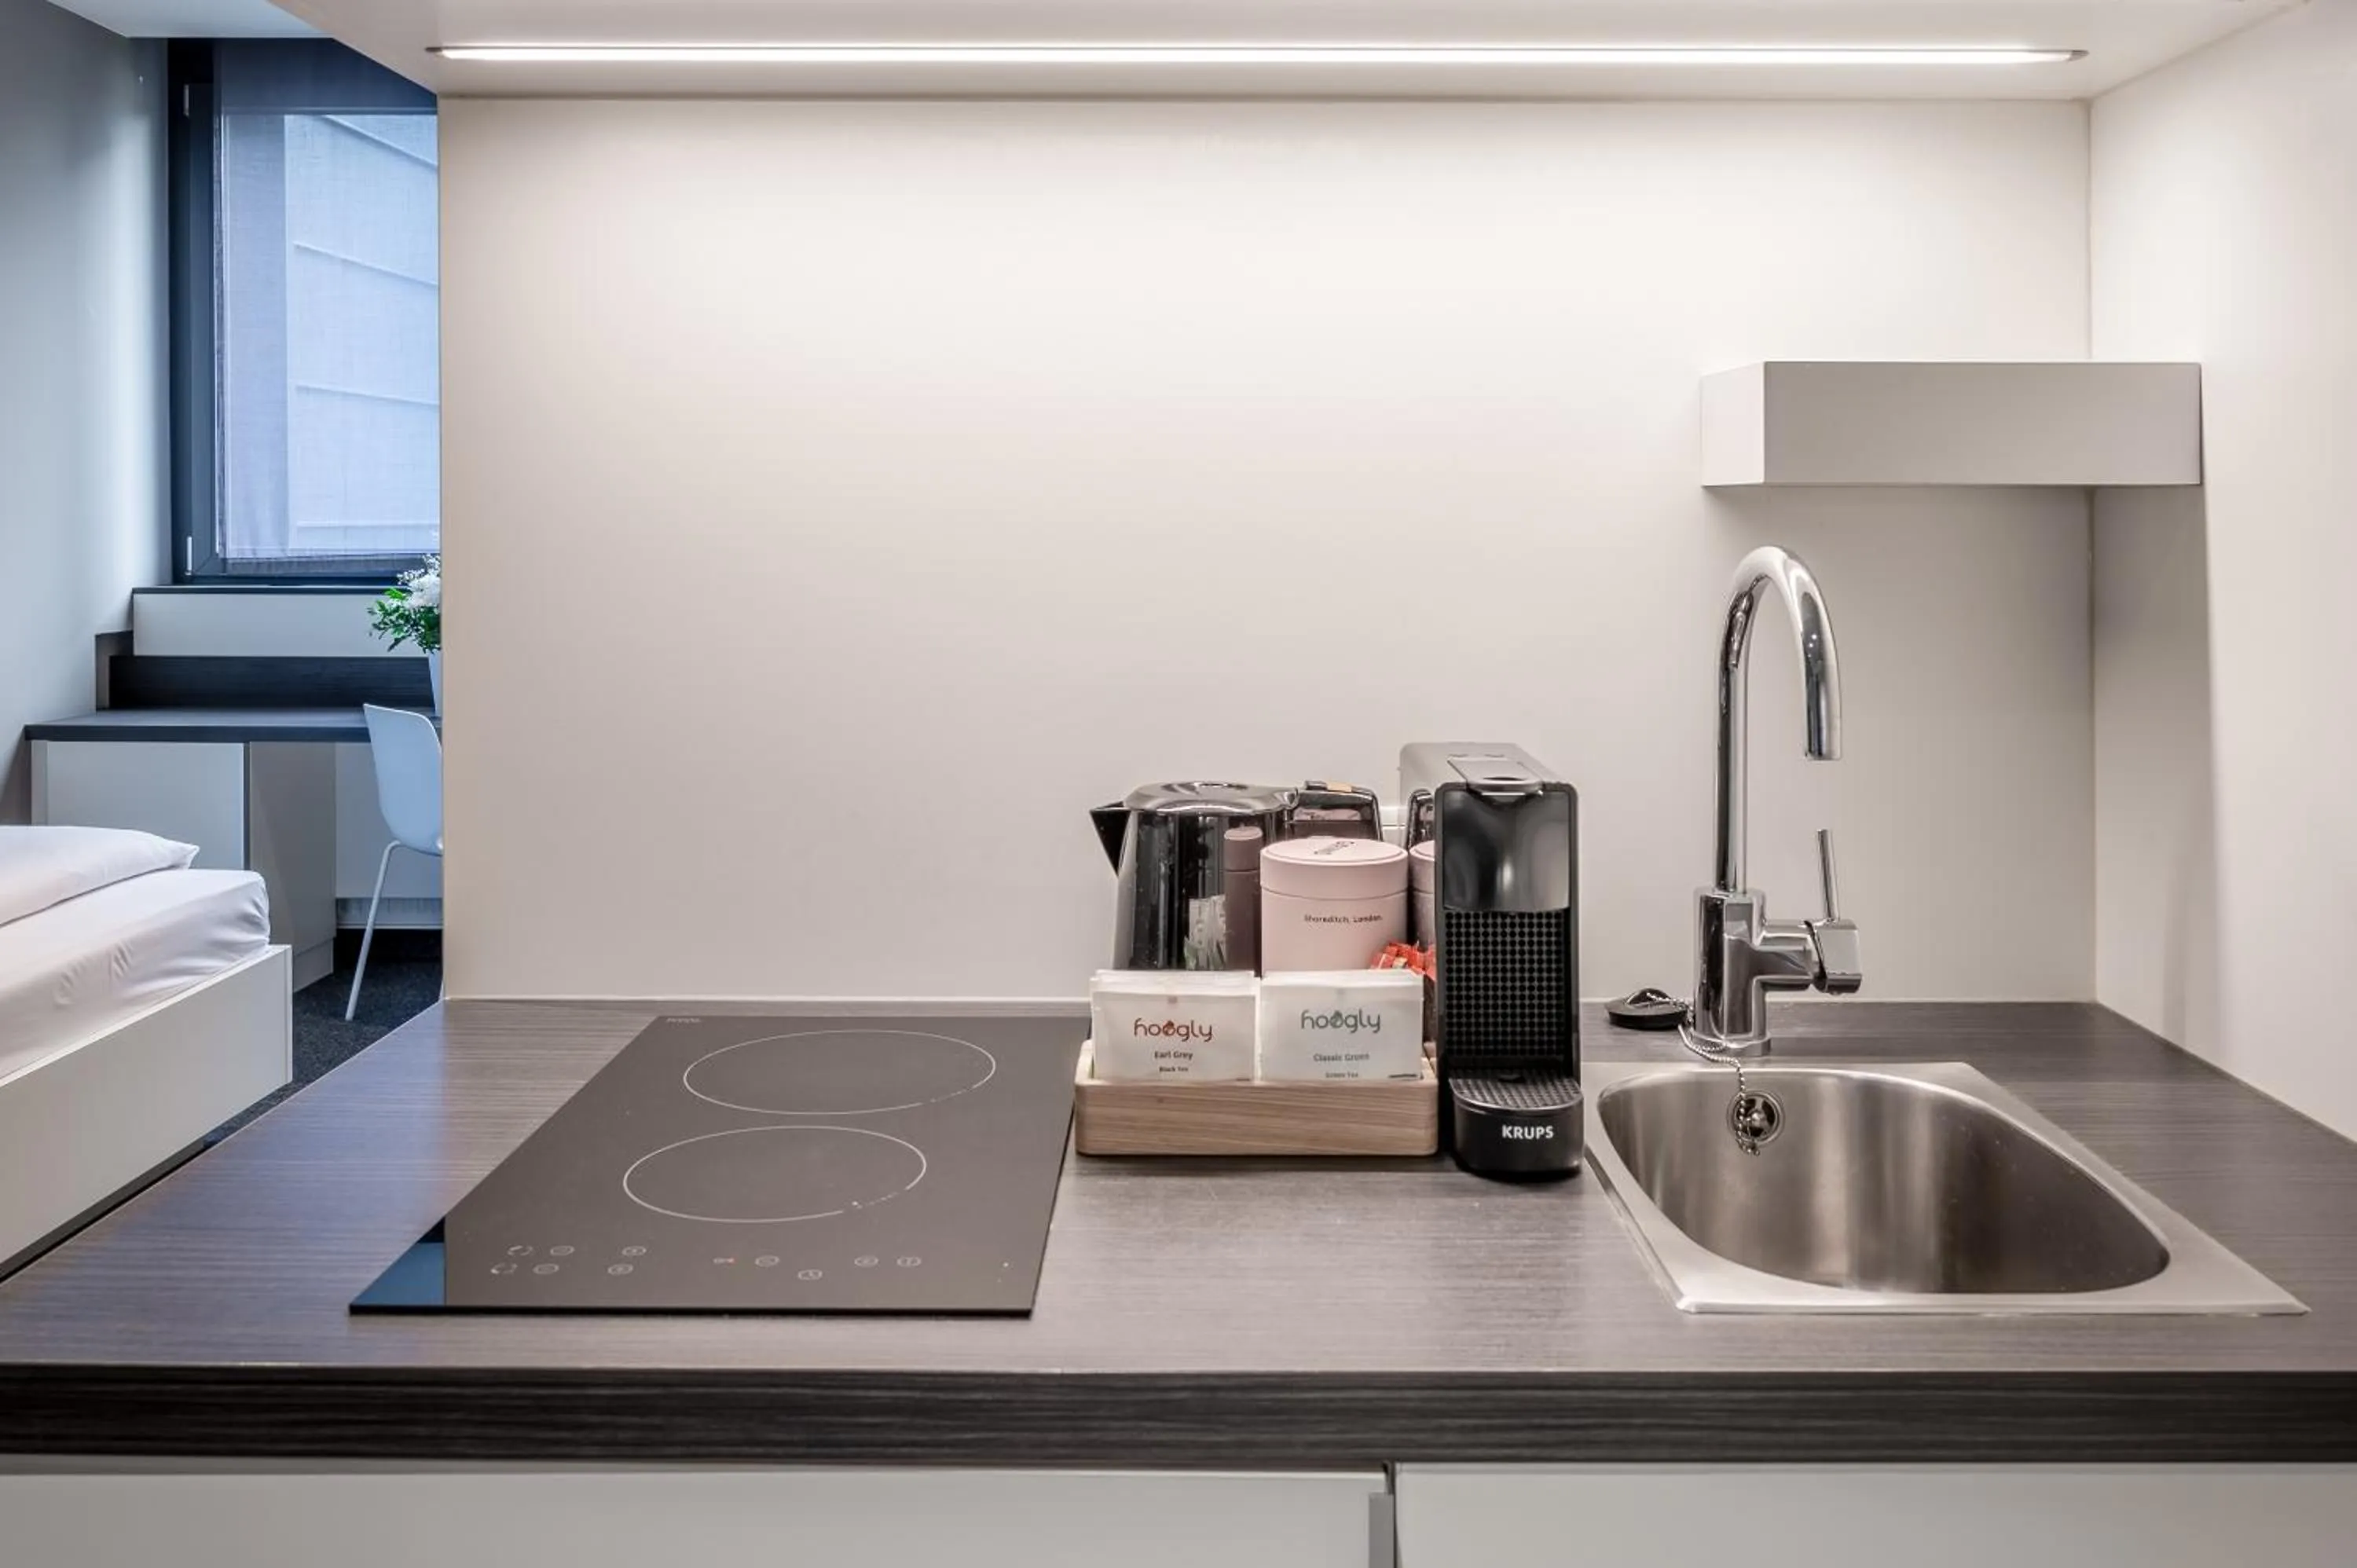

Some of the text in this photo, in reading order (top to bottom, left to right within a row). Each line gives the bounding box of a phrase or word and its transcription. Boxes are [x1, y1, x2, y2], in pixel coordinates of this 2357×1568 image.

[1134, 1017, 1212, 1042] hoogly
[1301, 1009, 1380, 1034] hoogly
[1173, 1051, 1193, 1061] Grey
[1313, 1053, 1342, 1062] Classic
[1501, 1124, 1554, 1140] KRUPS
